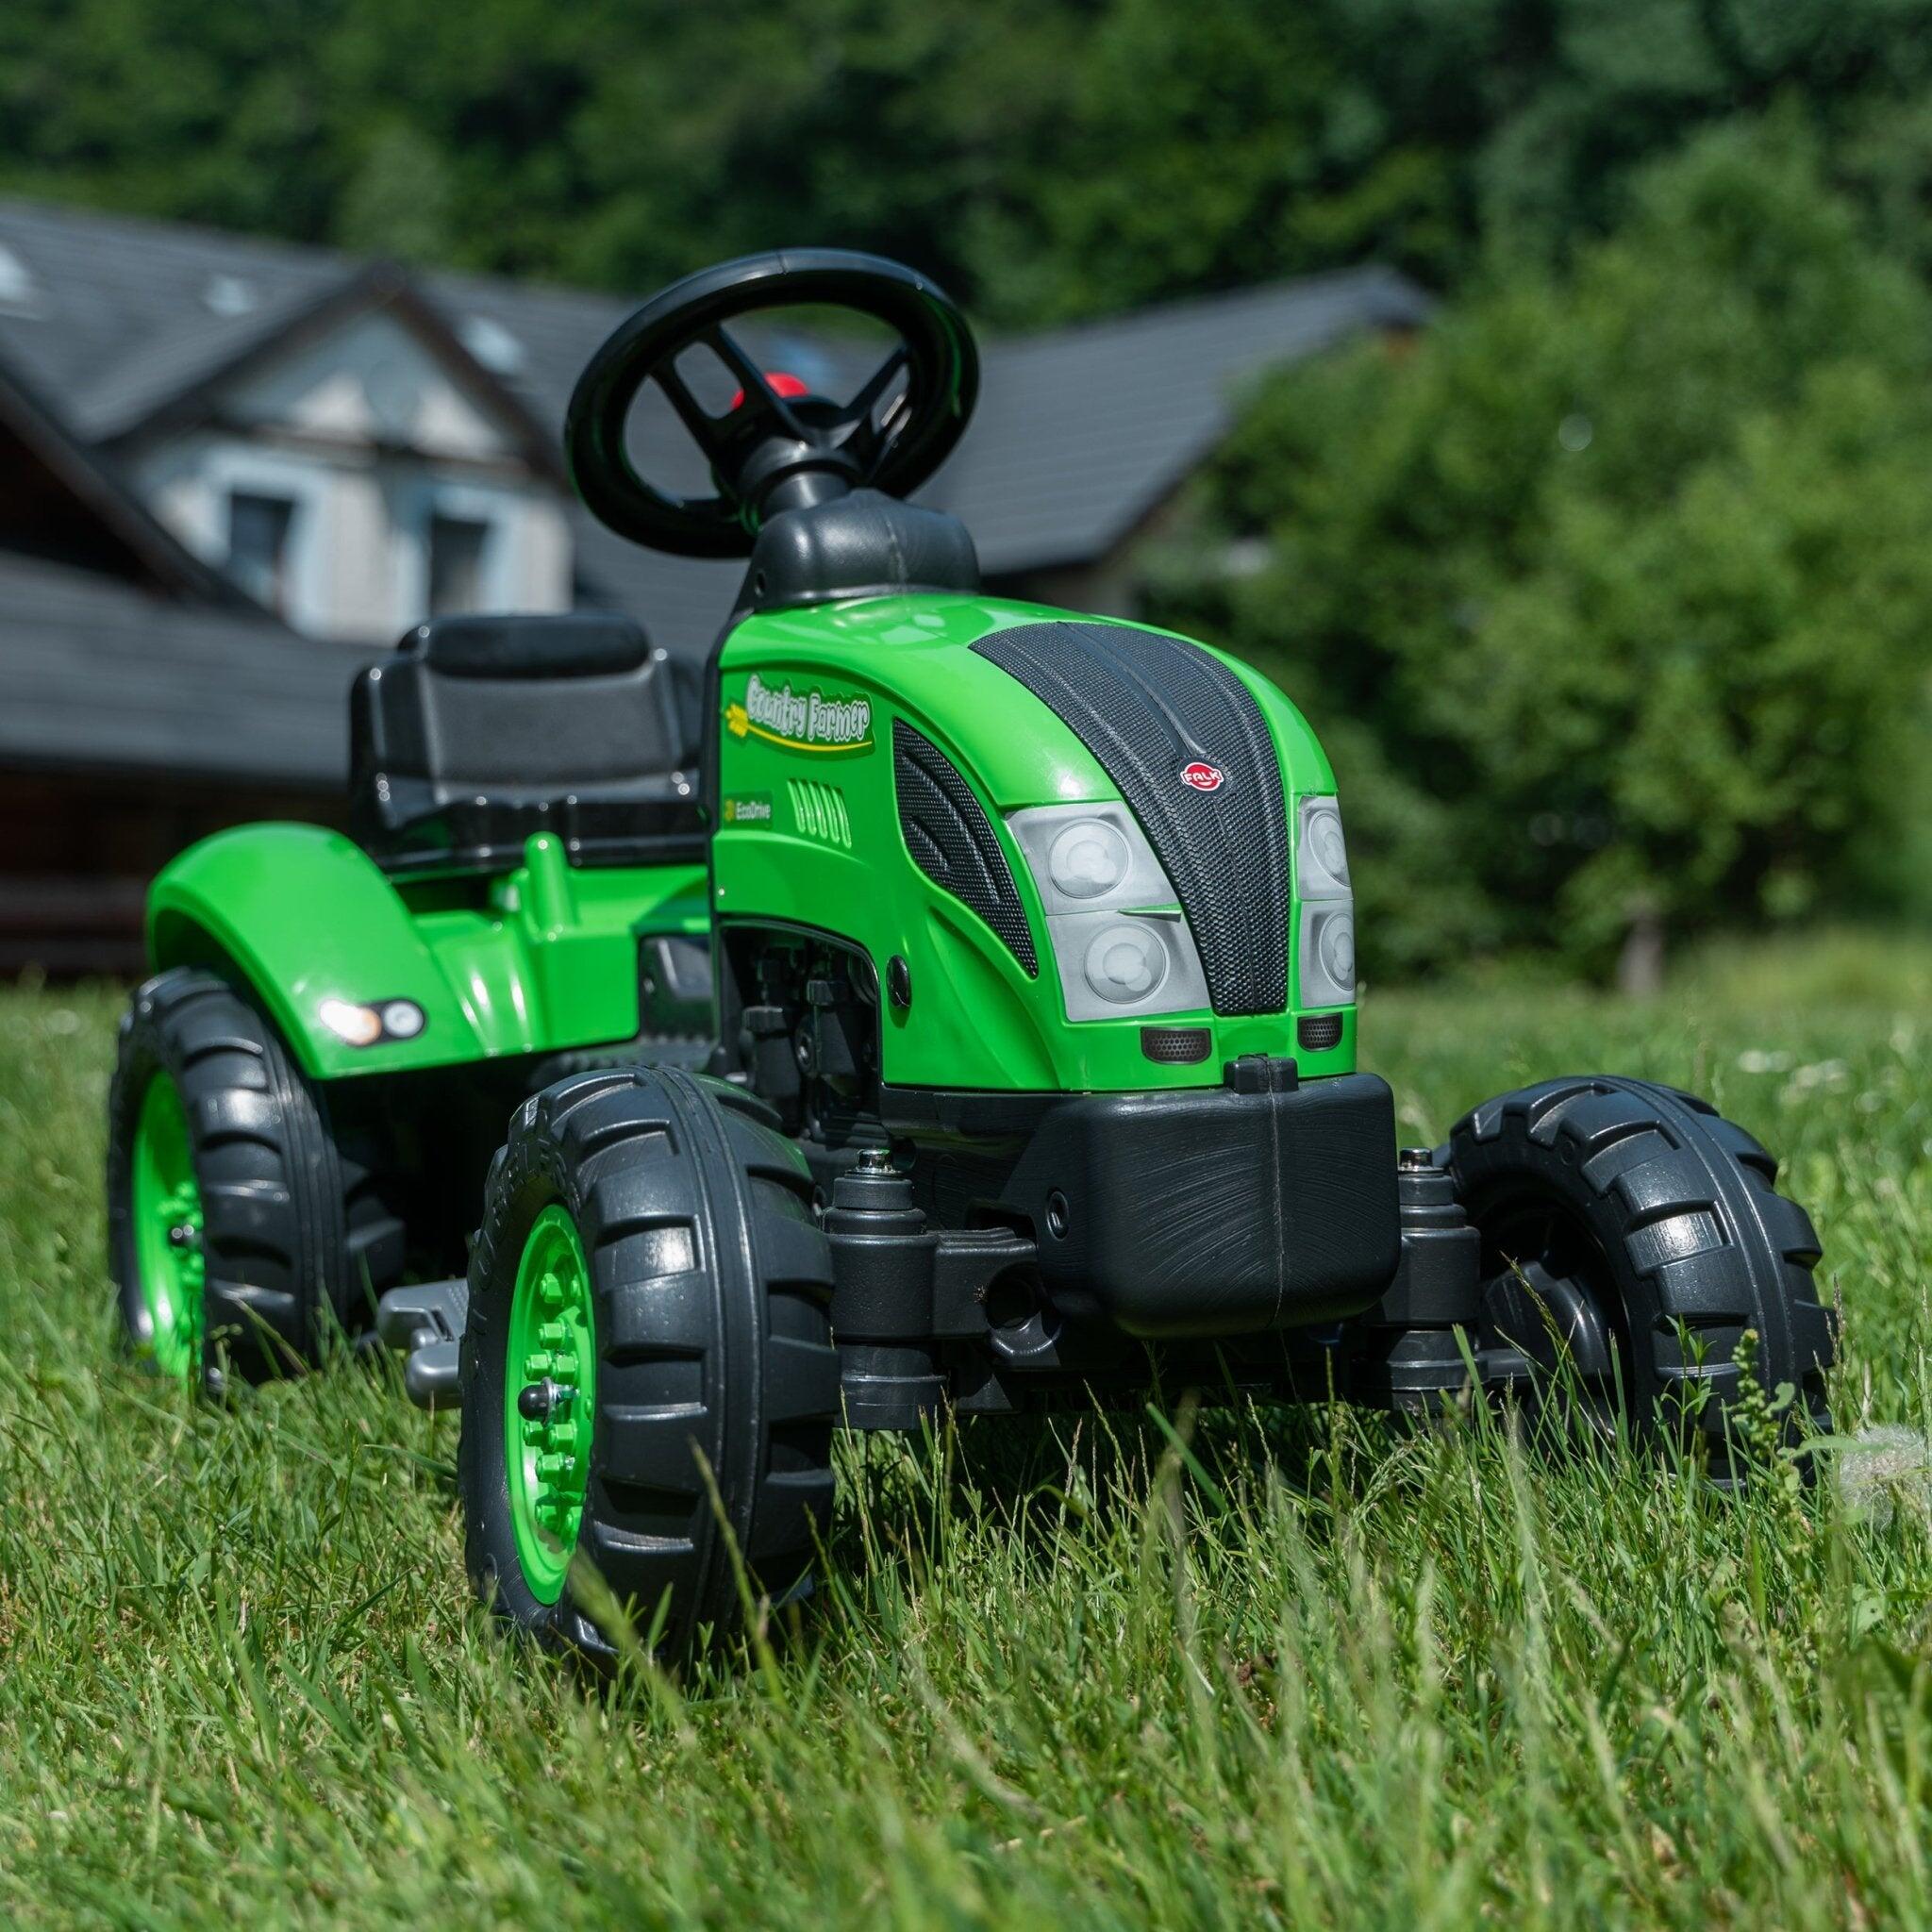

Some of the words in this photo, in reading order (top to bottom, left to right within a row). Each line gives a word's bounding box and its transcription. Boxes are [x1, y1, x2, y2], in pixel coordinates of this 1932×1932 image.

[746, 674, 808, 739] Country
[808, 692, 870, 741] Farmer
[1181, 768, 1223, 784] FALK
[736, 801, 771, 821] EcoDrive
